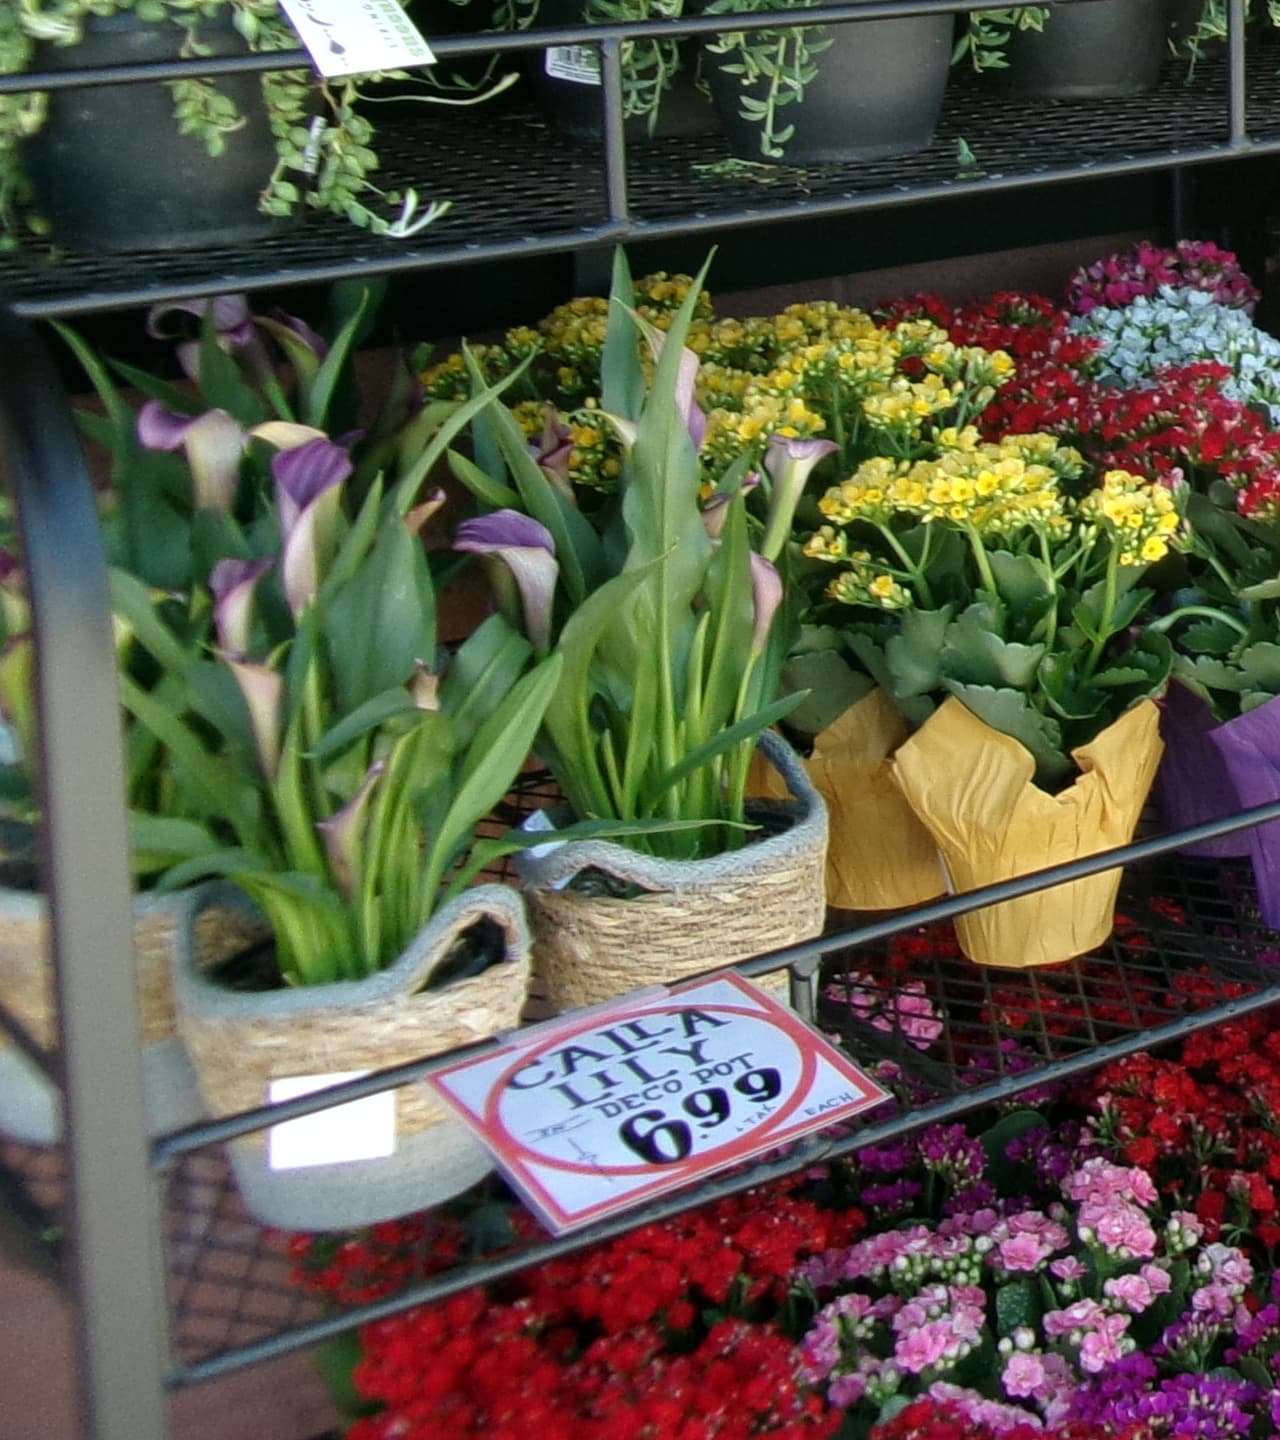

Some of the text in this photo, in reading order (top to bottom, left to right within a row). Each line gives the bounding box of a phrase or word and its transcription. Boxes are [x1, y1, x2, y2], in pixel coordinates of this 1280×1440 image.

[506, 1008, 731, 1091] CALLA
[550, 1039, 715, 1111] LILY
[595, 1078, 682, 1119] DECO
[695, 1052, 757, 1085] POT
[802, 1091, 854, 1117] EACH
